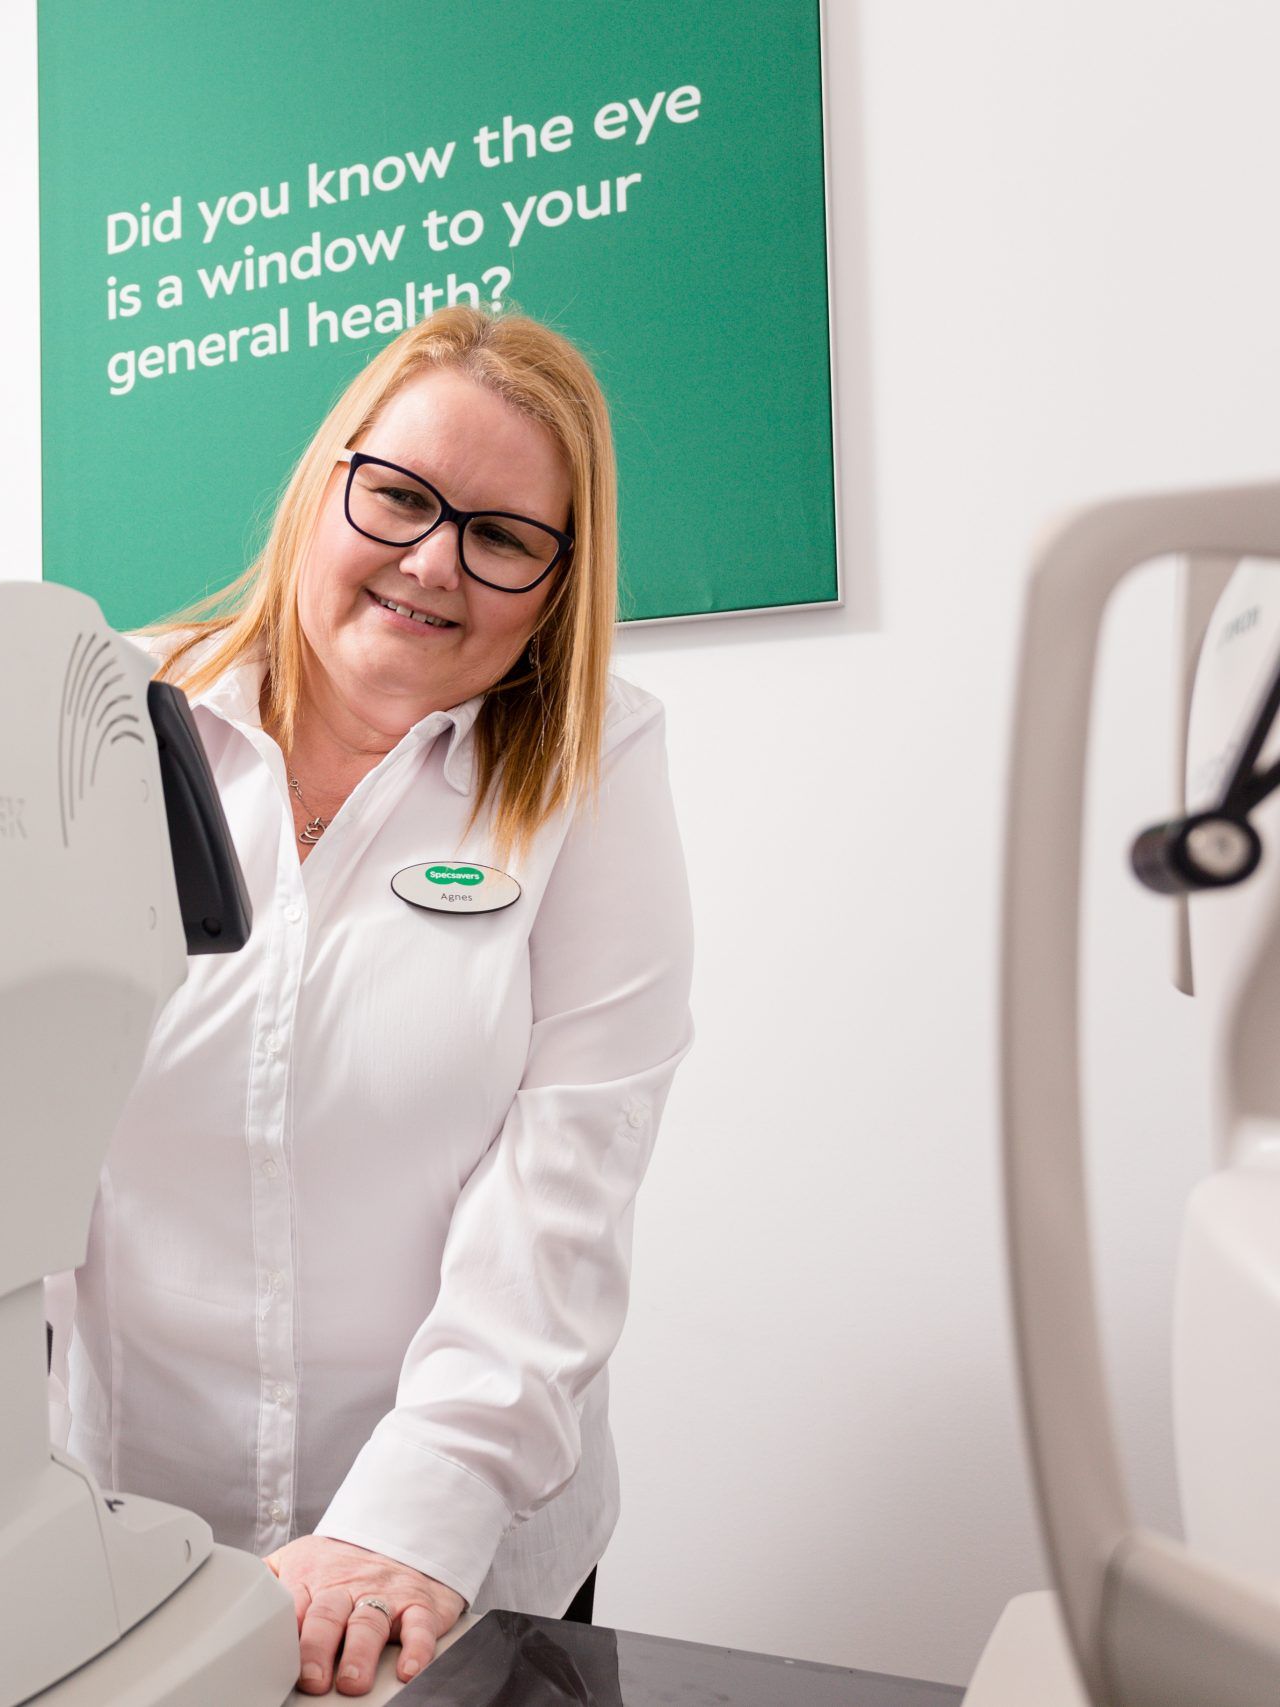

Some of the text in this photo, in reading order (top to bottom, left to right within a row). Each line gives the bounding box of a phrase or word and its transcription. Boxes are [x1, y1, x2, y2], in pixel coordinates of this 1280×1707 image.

[107, 85, 701, 255] Did you know the eye
[107, 173, 642, 321] is a window to your
[107, 266, 512, 396] general health?
[430, 871, 480, 879] Specsavers
[441, 893, 473, 902] Agnes
